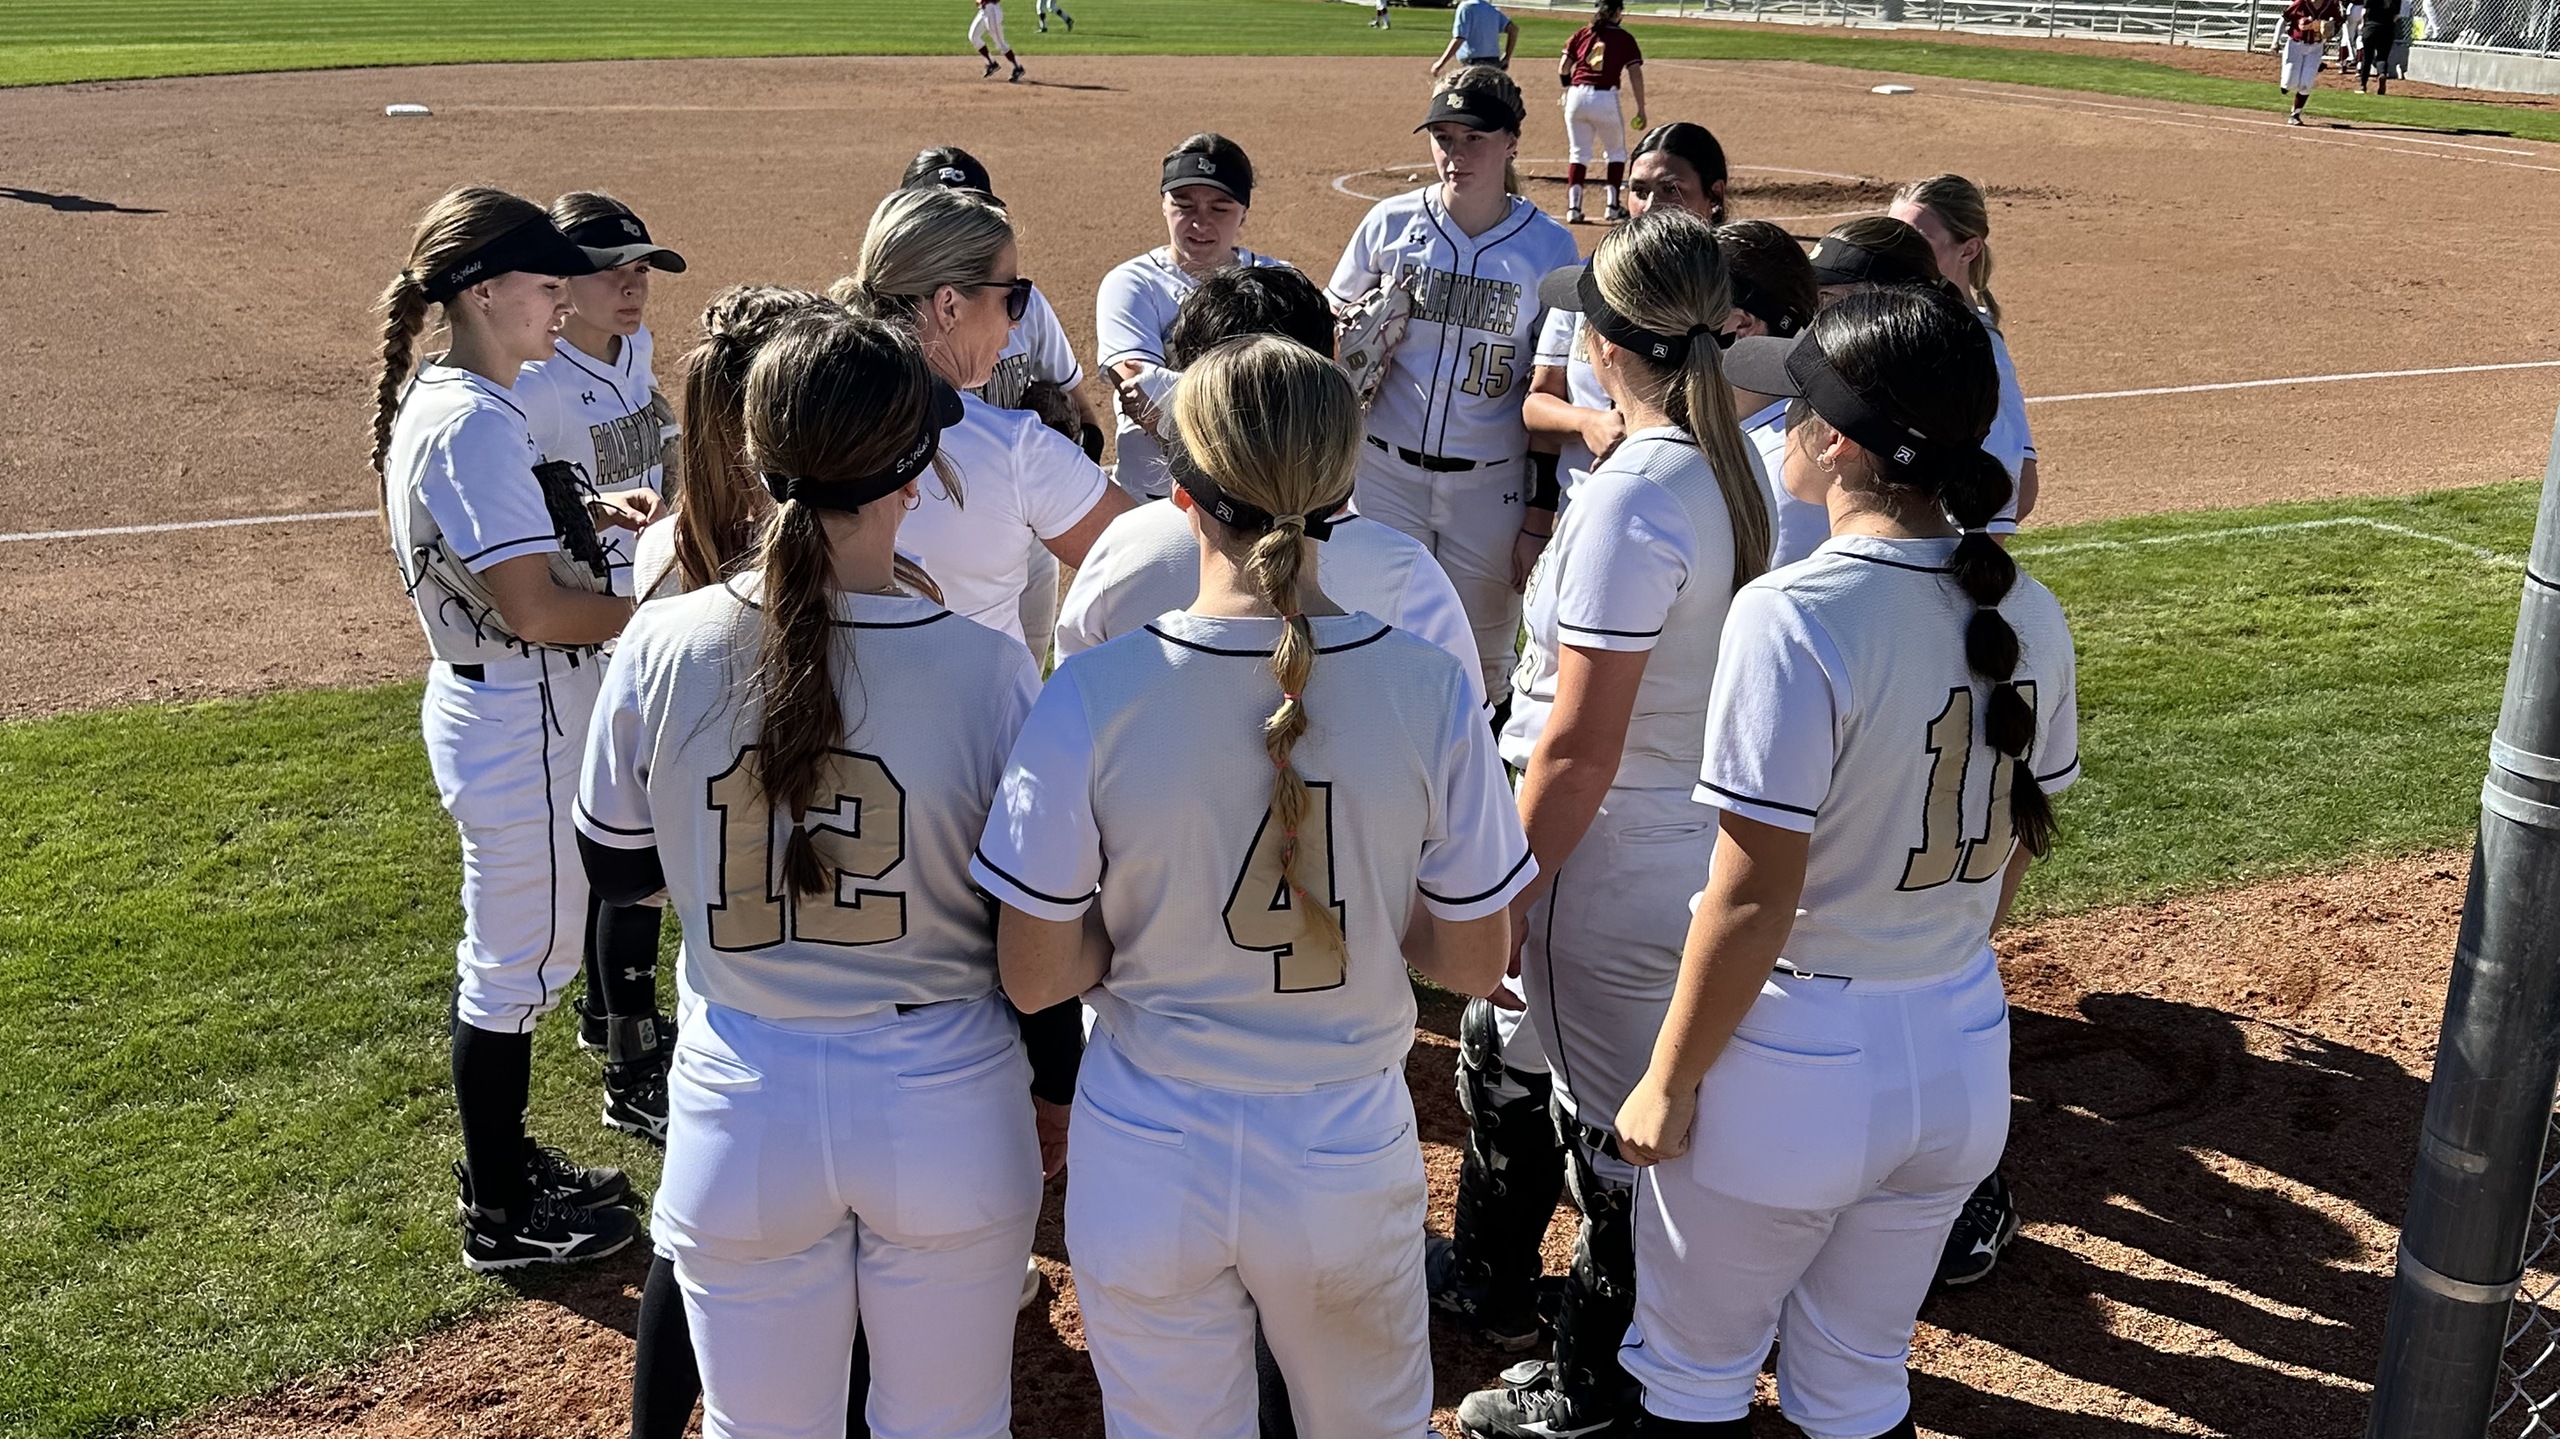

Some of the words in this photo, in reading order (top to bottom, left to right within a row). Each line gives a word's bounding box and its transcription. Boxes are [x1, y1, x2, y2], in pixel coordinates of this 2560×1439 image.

[1460, 341, 1516, 399] 15
[706, 744, 907, 953] 12
[1221, 780, 1347, 994] 4
